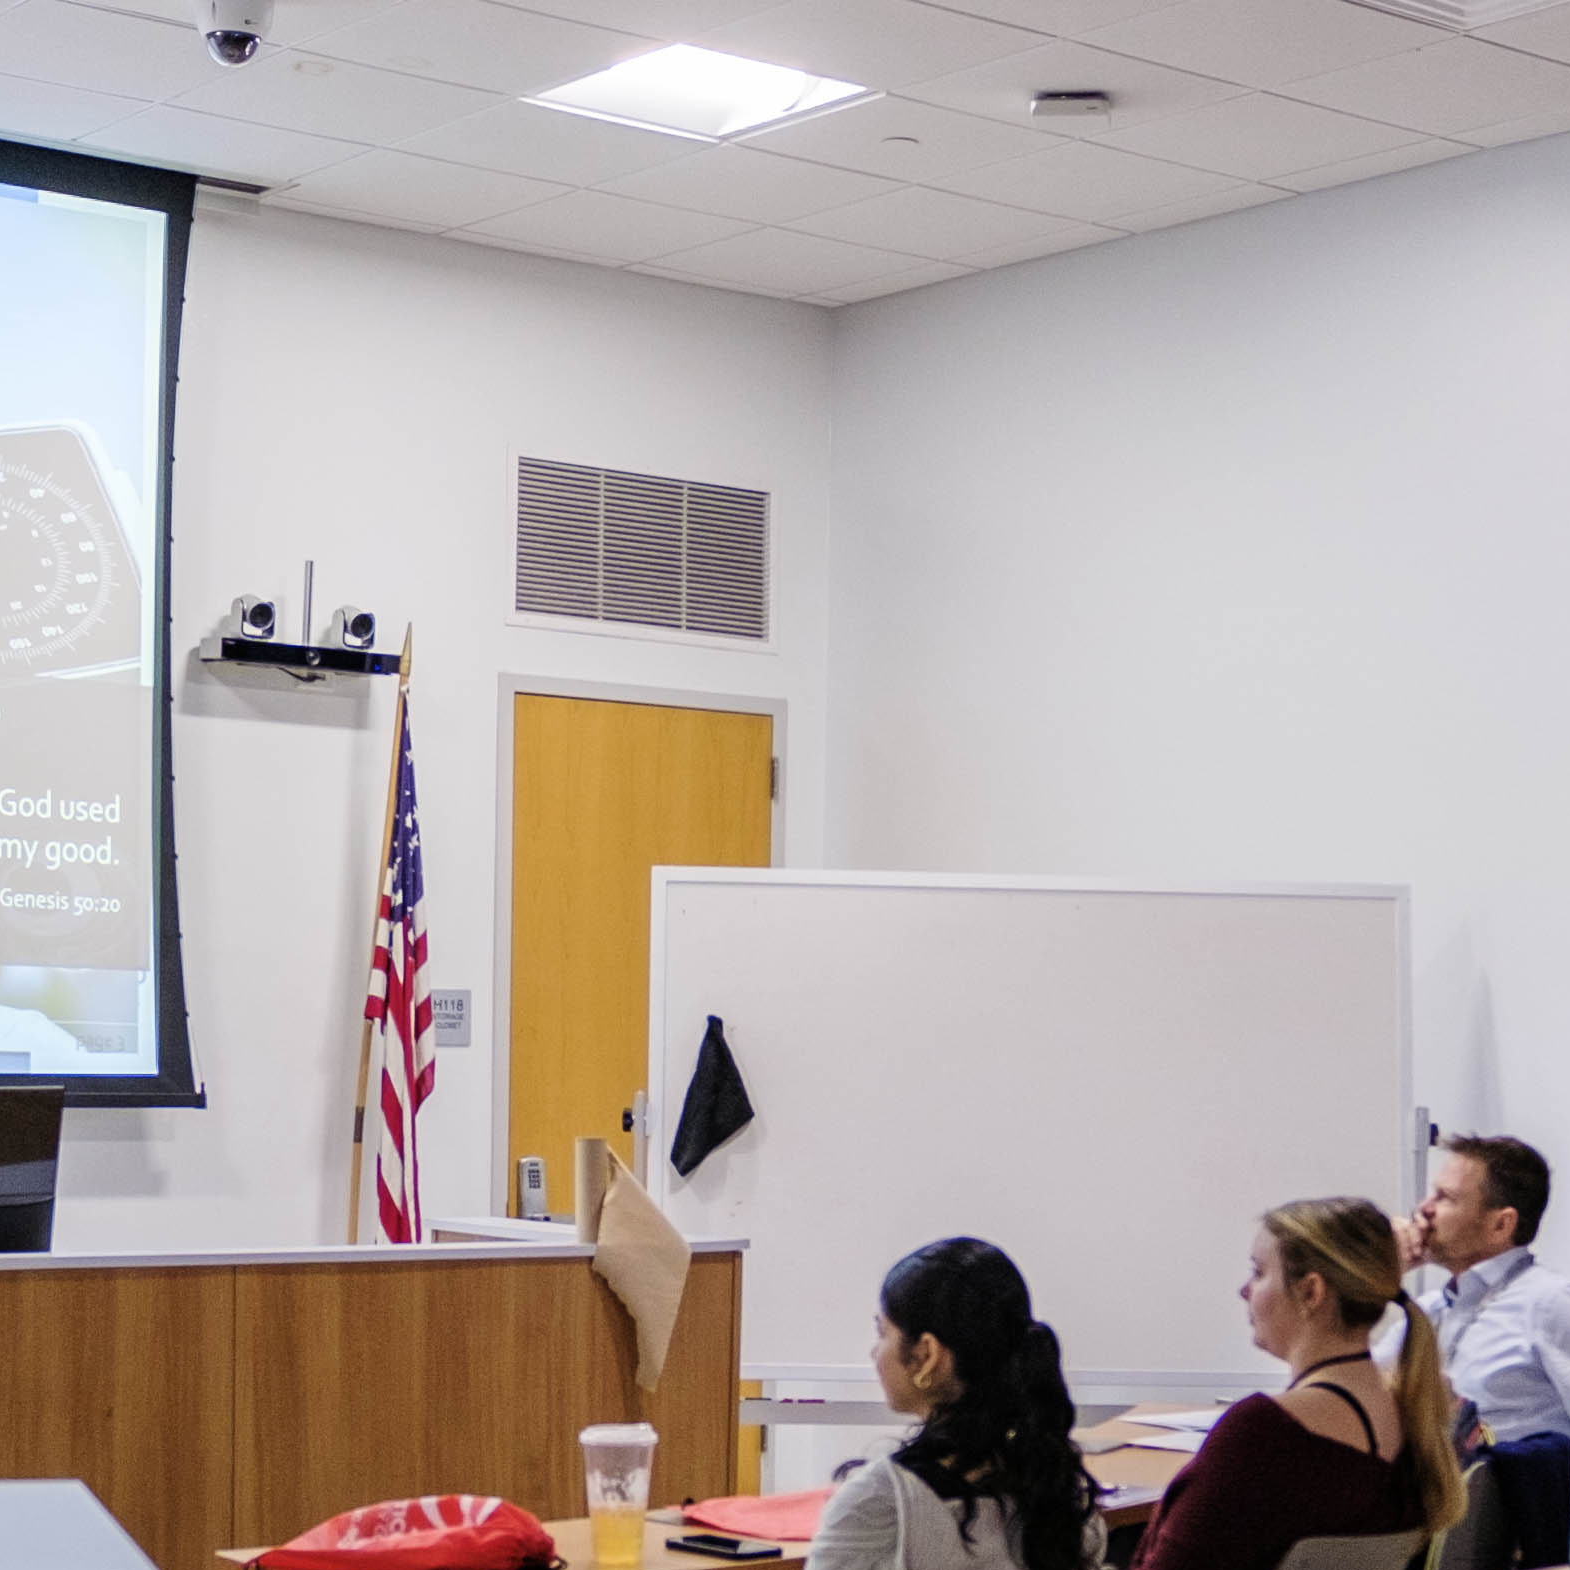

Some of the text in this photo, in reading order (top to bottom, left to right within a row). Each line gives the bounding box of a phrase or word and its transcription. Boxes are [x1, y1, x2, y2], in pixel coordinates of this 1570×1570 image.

[59, 793, 121, 824] used
[44, 835, 120, 871] good.
[73, 895, 121, 916] 50:20
[433, 999, 464, 1012] H118
